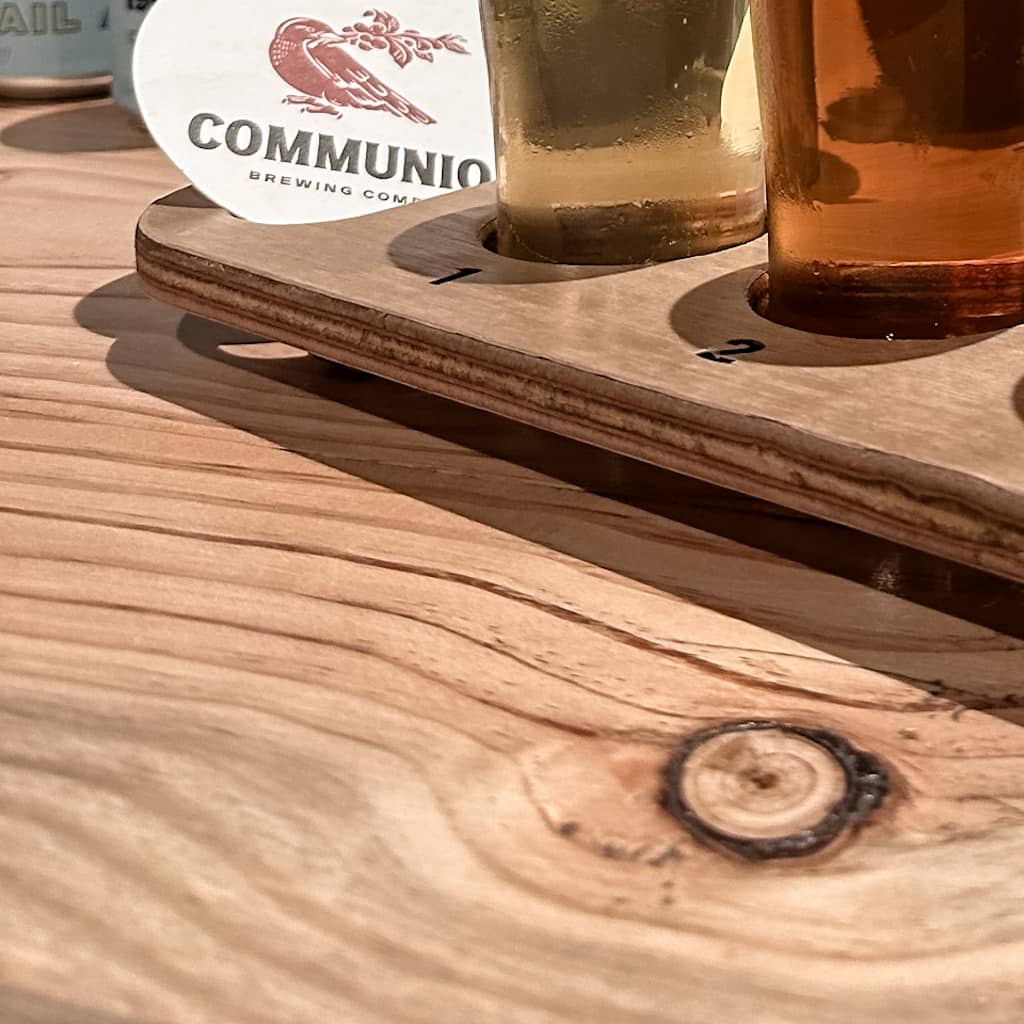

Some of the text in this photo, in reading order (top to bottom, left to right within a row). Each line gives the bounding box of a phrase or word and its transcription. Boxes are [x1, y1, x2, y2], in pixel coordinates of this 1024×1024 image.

[249, 170, 353, 196] BREWING
[429, 267, 483, 285] 1
[696, 338, 766, 364] 2
